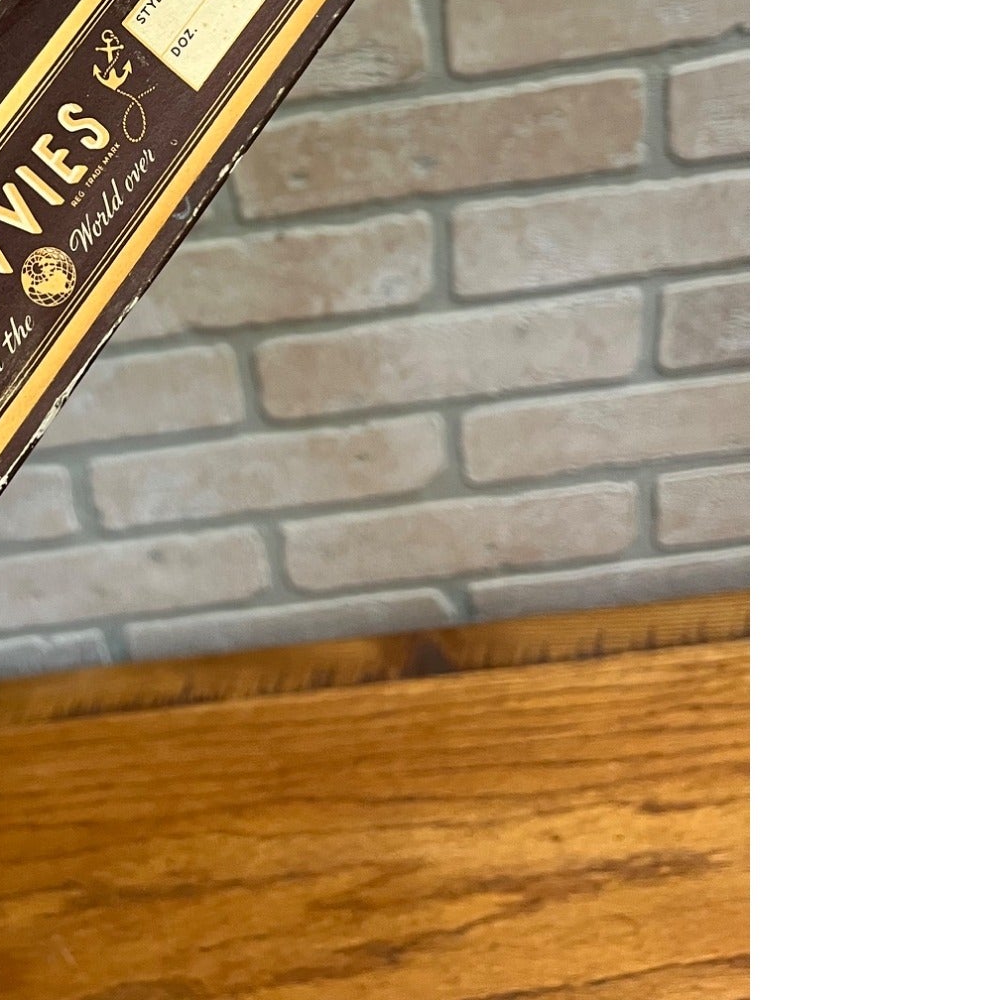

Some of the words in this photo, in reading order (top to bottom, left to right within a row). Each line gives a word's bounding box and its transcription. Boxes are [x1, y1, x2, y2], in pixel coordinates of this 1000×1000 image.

[170, 28, 198, 58] DOZ.
[85, 164, 105, 188] TRADE
[101, 142, 121, 165] MARK
[2, 314, 35, 354] the
[69, 177, 124, 253] World
[124, 148, 156, 193] over
